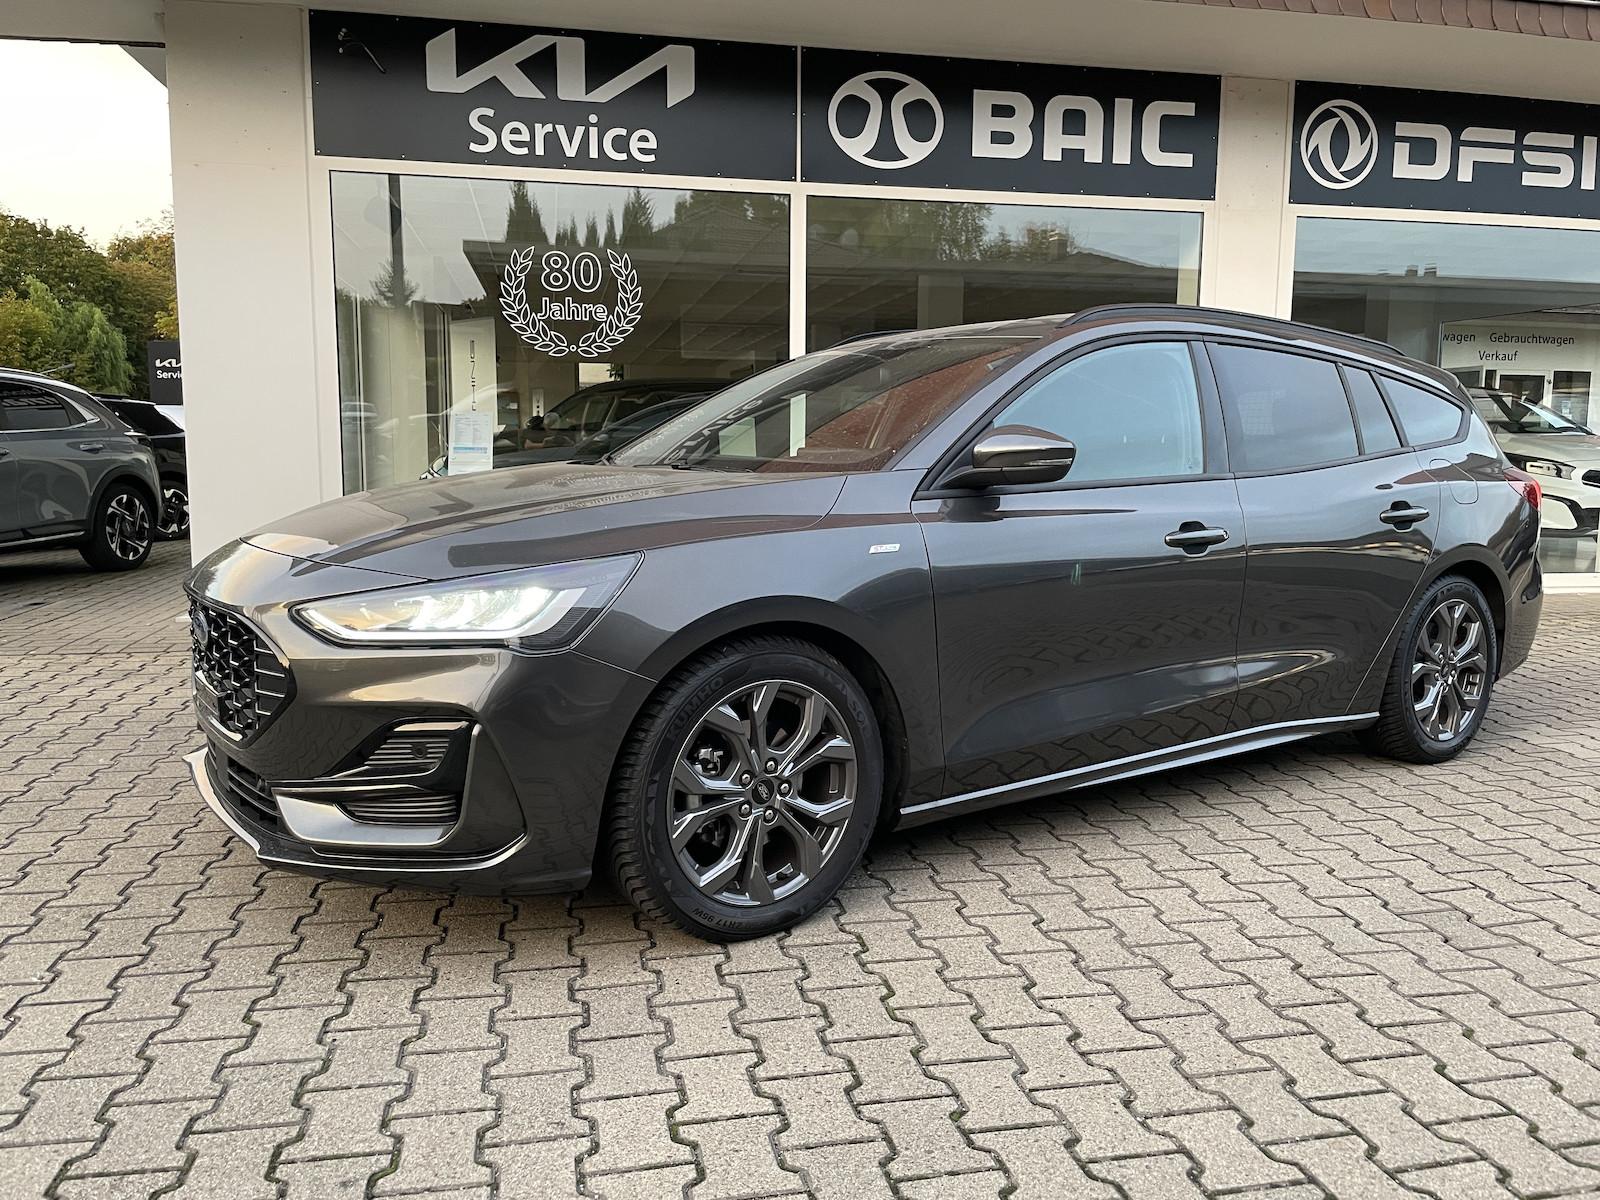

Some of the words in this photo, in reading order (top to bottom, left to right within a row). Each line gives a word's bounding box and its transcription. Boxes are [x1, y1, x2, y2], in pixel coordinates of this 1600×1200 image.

[425, 27, 695, 108] KIA
[468, 107, 658, 162] Service
[971, 89, 1196, 168] BAIC
[540, 250, 602, 292] 80
[537, 296, 608, 322] Jahre
[1478, 350, 1519, 361] Verkauf
[1489, 332, 1575, 347] Gebrauchtwagen
[666, 677, 725, 740] KUMHO
